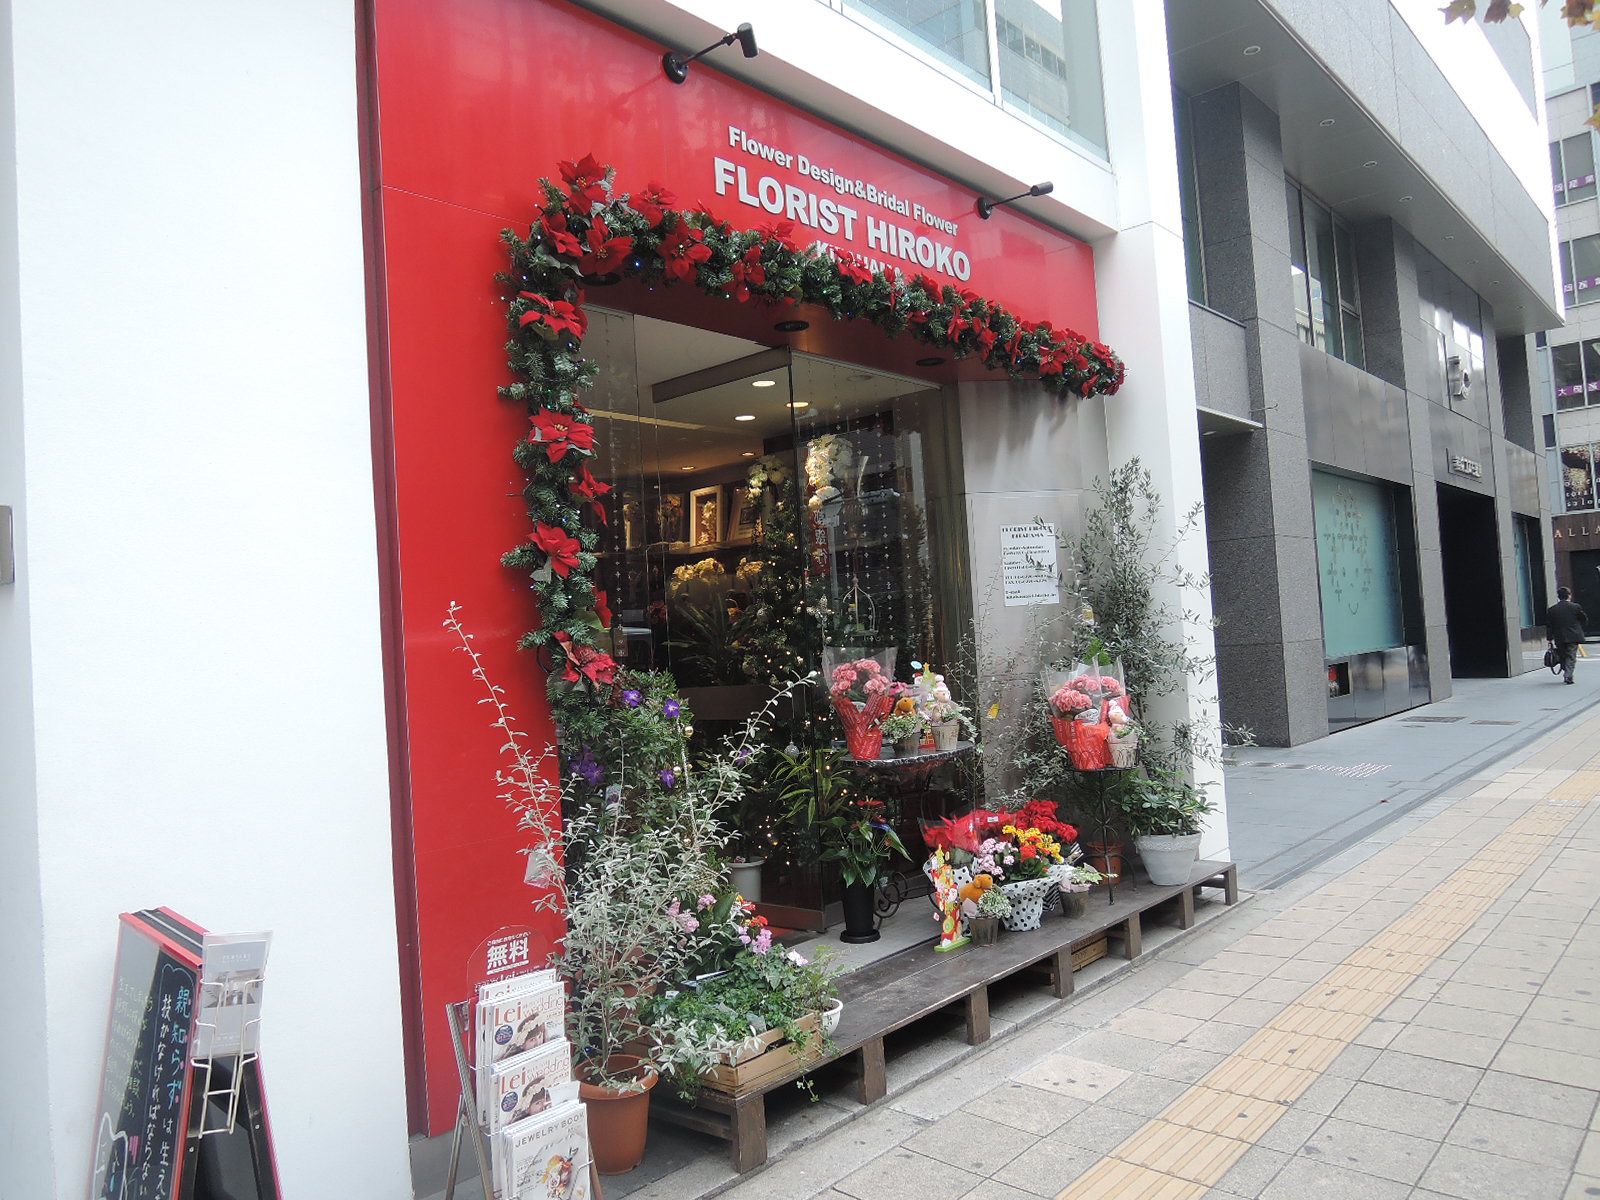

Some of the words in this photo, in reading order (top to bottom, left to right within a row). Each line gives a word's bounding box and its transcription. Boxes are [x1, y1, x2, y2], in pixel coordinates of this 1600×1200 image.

[728, 125, 794, 169] Flower
[797, 154, 910, 218] Design&Bridal
[912, 204, 958, 236] Flower
[713, 156, 858, 242] FLORIST
[866, 215, 972, 282] HIROKO
[487, 936, 529, 970] 無料
[515, 1123, 560, 1148] JEWELRY
